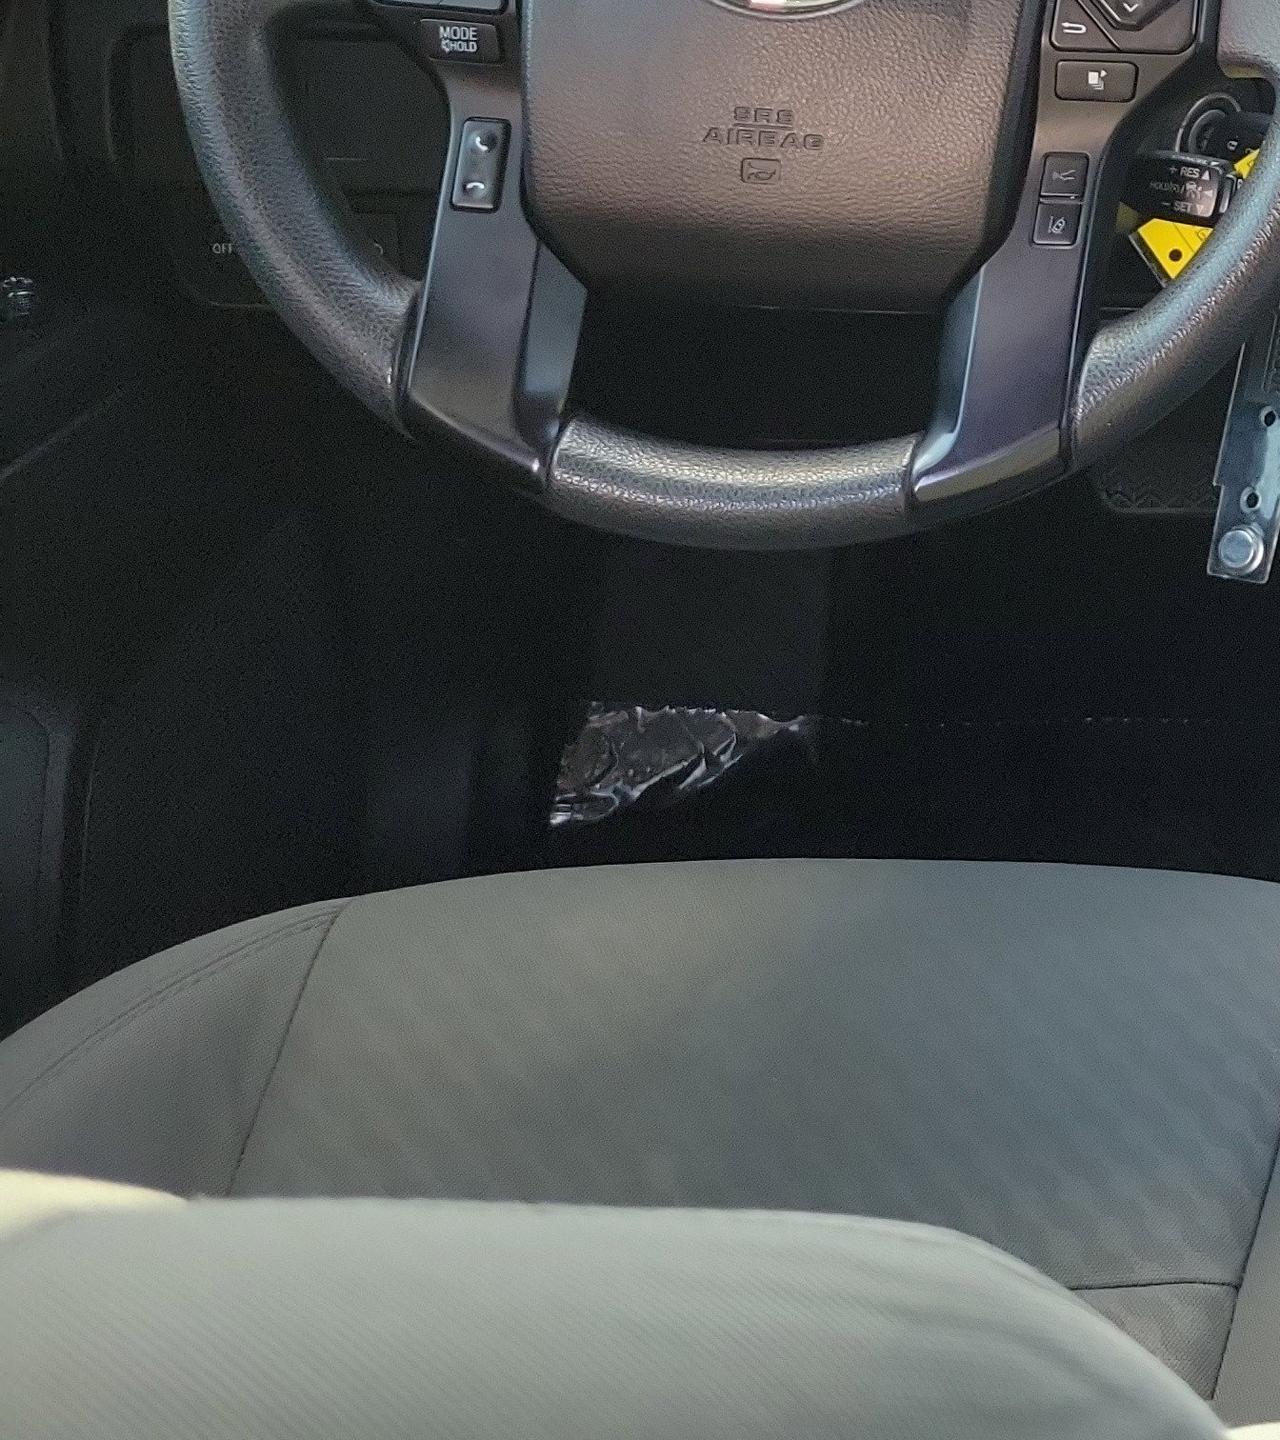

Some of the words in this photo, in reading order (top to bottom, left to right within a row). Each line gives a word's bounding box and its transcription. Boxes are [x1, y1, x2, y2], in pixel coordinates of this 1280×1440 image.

[439, 26, 478, 40] MODE
[450, 41, 478, 52] HOLD
[702, 126, 824, 150] AIRBAG
[1180, 166, 1200, 178] RES
